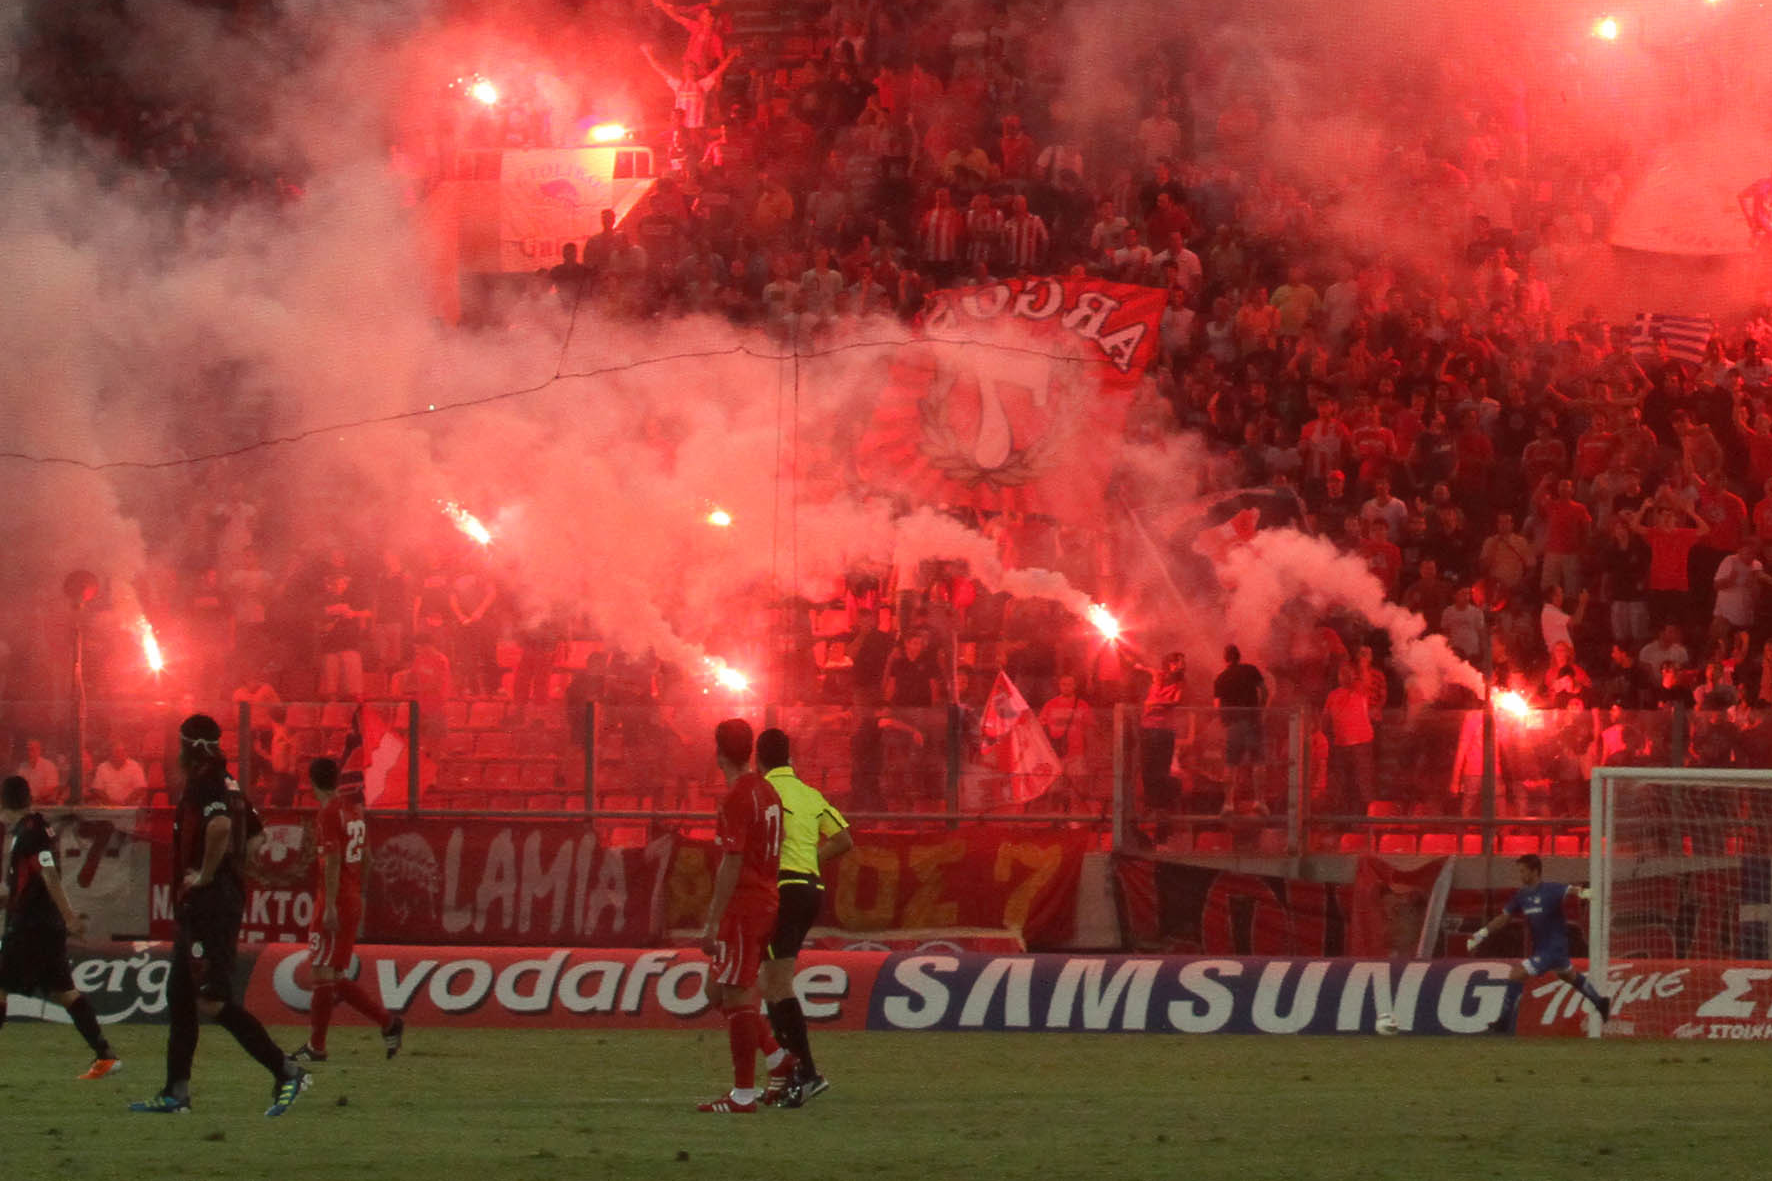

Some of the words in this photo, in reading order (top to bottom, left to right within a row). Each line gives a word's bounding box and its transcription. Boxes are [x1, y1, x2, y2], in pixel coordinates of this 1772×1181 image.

[440, 827, 628, 937] LAMIA
[71, 951, 172, 1013] erg
[376, 949, 849, 1019] vodafoe
[883, 955, 1514, 1034] SAMSUNG
